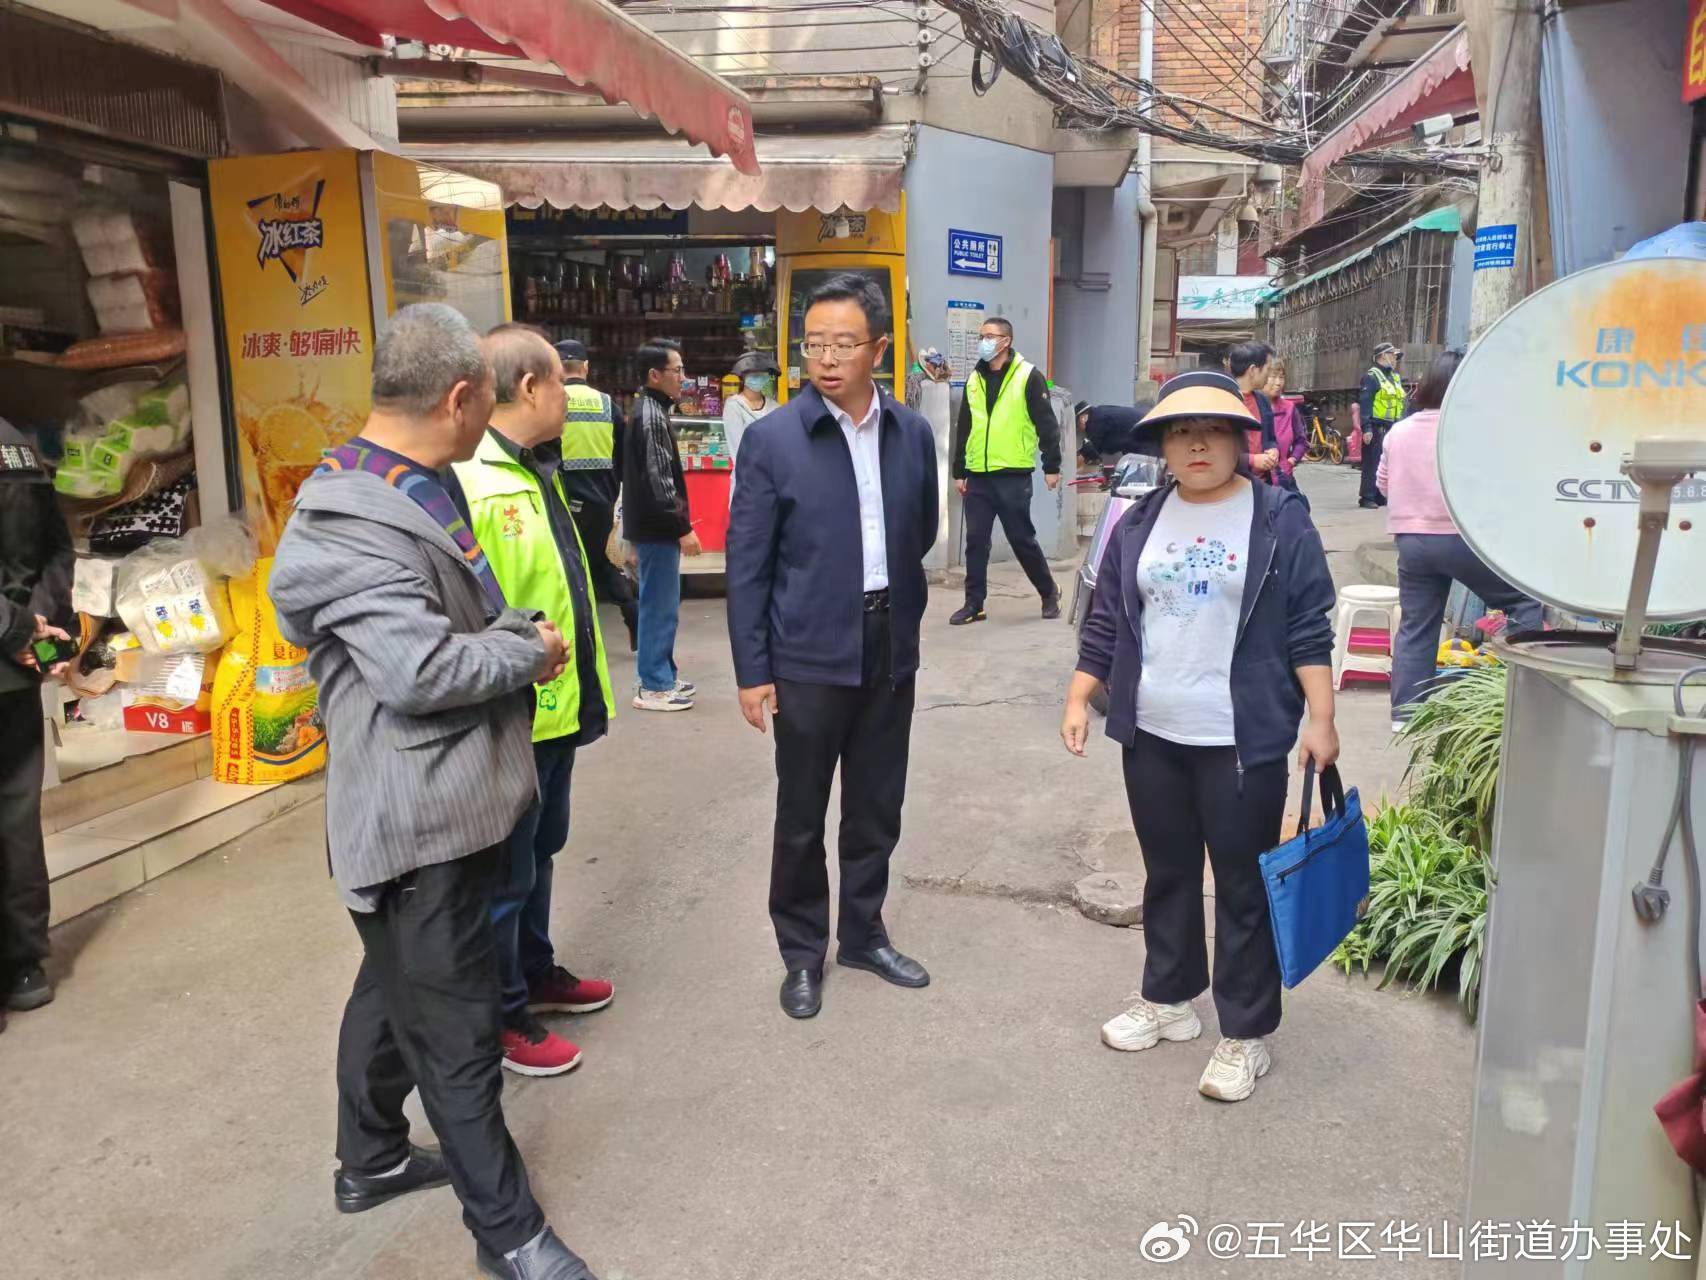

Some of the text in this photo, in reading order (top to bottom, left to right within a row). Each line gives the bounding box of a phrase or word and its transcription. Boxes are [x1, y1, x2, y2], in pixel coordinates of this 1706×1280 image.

[258, 218, 323, 264] 冰红茶
[953, 238, 985, 252] 公共厕所
[953, 249, 985, 259] PUBLIC TOILET
[241, 326, 363, 359] 冰爽·够痛快
[145, 711, 169, 729] V8
